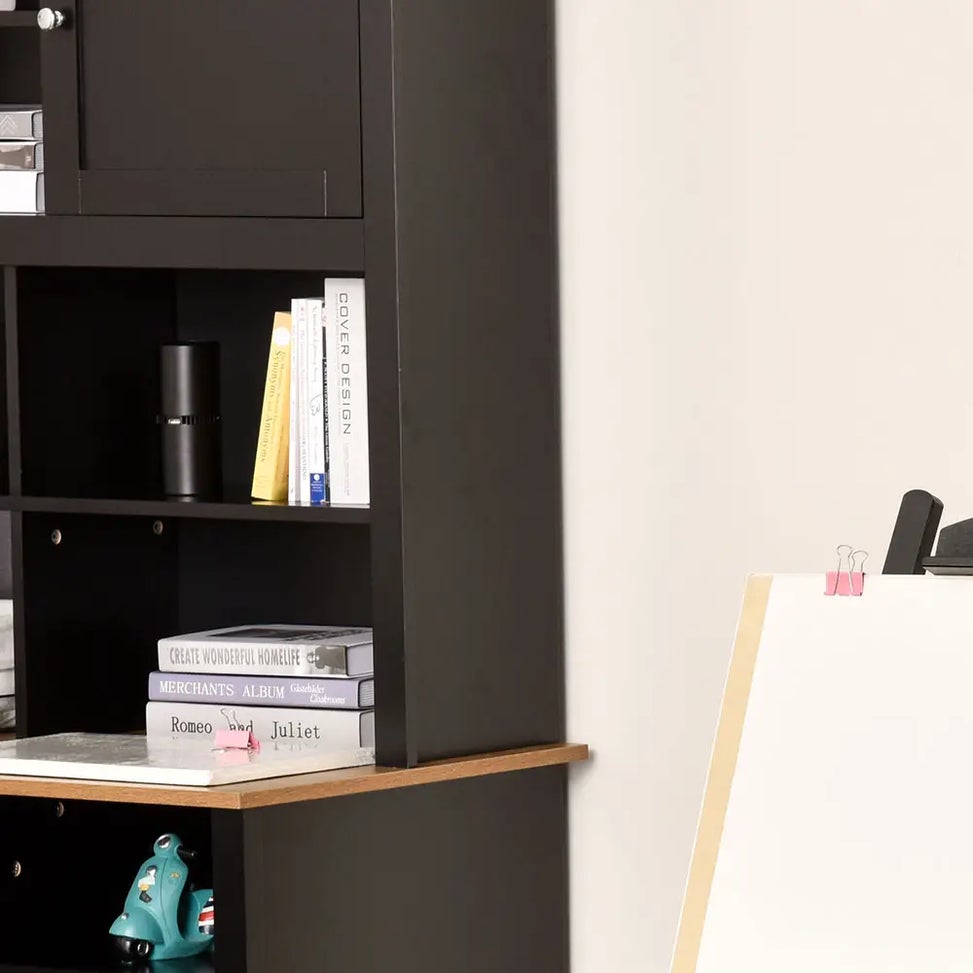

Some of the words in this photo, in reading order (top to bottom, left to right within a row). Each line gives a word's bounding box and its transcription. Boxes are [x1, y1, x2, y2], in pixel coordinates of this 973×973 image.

[339, 293, 350, 355] COVER
[341, 363, 352, 435] DESIGN
[169, 647, 200, 665] CREATE
[202, 647, 255, 666] WONDERFUL
[257, 649, 301, 667] HOMELIFE
[159, 680, 234, 696] MERCHANTS
[242, 683, 285, 699] ALBUM
[171, 716, 213, 735] Romeo
[271, 721, 321, 740] Juliet
